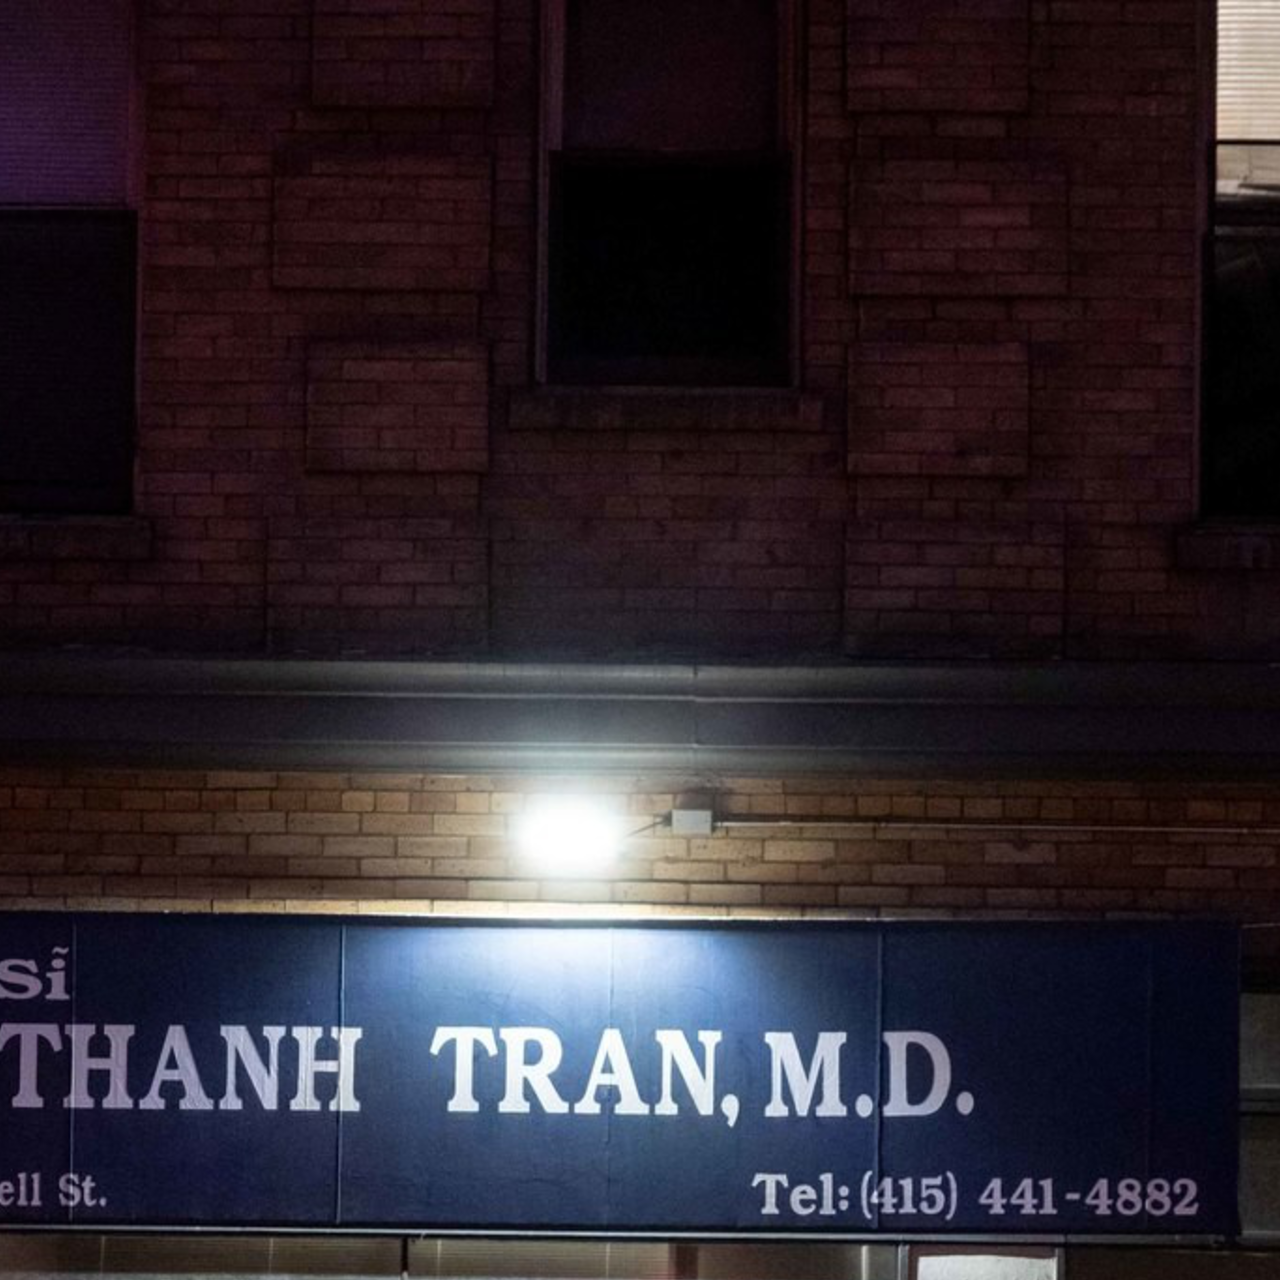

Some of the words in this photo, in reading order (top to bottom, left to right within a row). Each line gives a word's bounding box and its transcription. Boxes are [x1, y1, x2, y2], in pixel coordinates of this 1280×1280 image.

[429, 1025, 740, 1127] TRAN,
[763, 1030, 975, 1118] M.D.
[58, 1172, 108, 1208] St.
[751, 1172, 850, 1217] Tel:
[859, 1169, 958, 1221] (415)
[977, 1177, 1200, 1217] 441-4882
